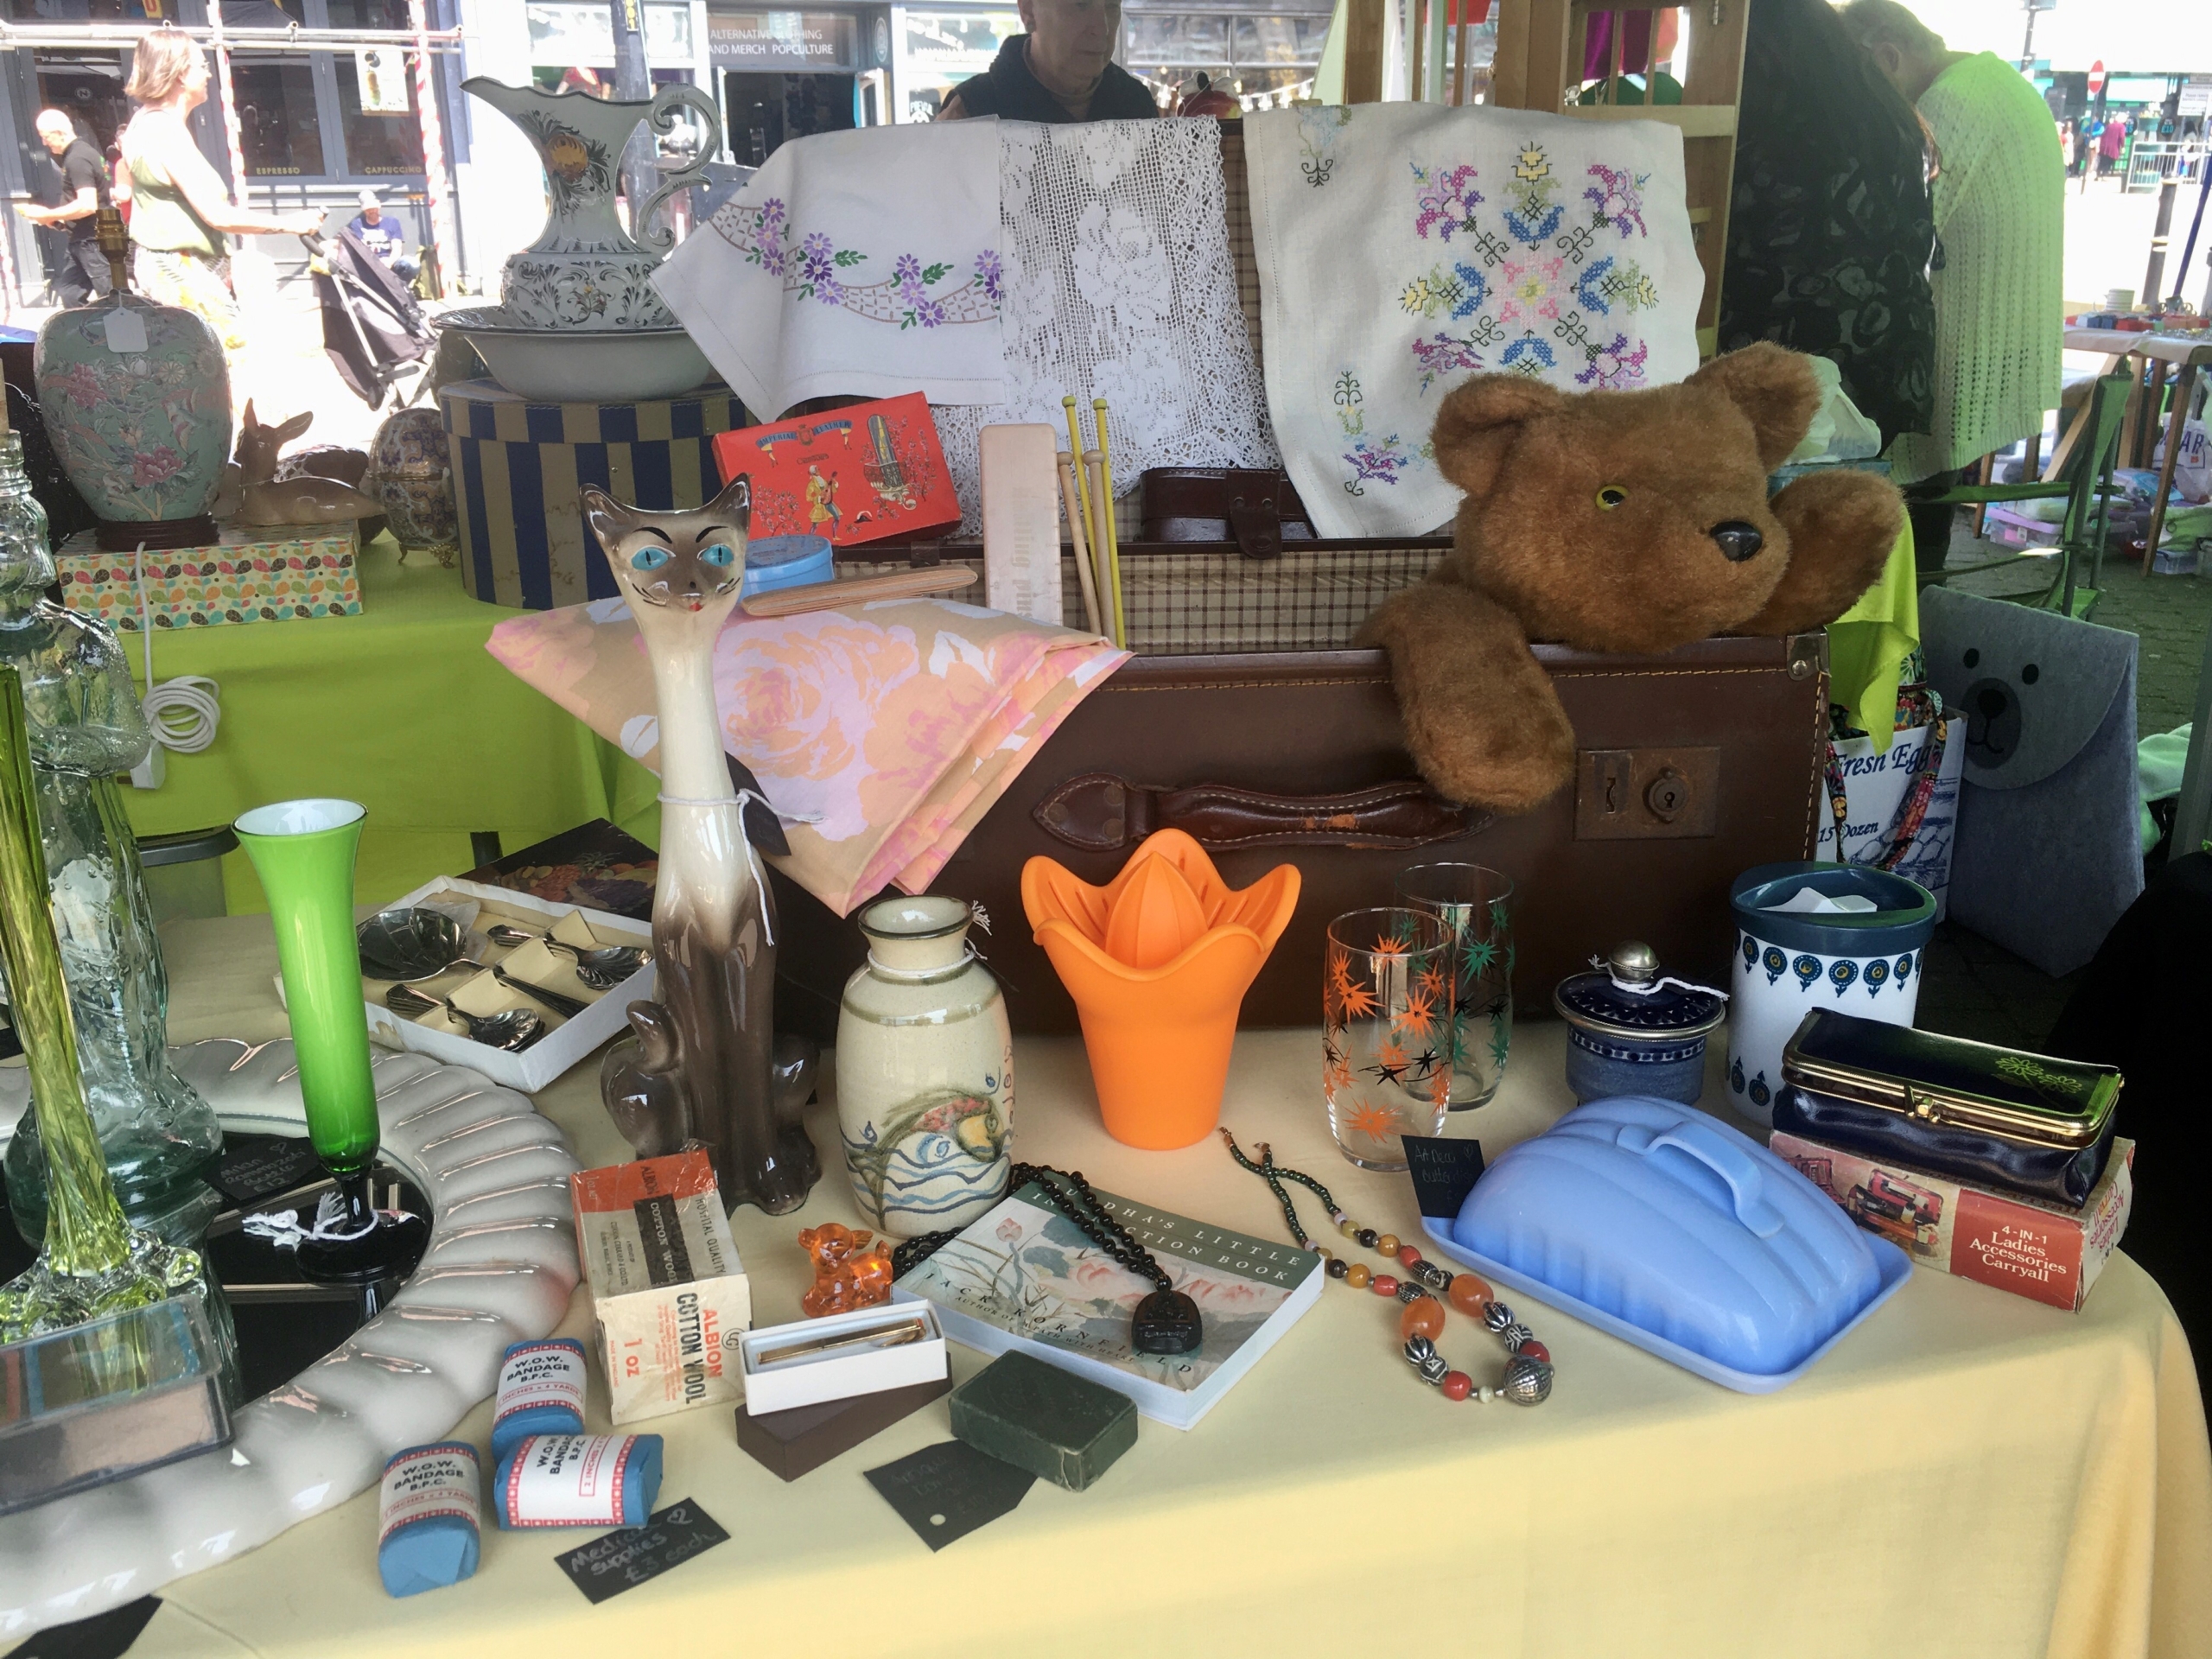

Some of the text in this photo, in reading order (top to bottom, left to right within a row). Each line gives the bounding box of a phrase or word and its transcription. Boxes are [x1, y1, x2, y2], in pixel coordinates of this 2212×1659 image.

[710, 29, 772, 40] ALTERNATIVE
[709, 44, 834, 54] AND MERCH POPCULTURE
[365, 166, 423, 175] CAPPUCCINO
[760, 420, 852, 447] IMPERIAL LEATHER
[1818, 827, 1834, 843] 15
[640, 1166, 660, 1194] ALBION
[650, 1202, 669, 1246] COTTON
[695, 1198, 728, 1274] HOSPITAL QUALITY
[1194, 1230, 1300, 1266] LITTLE
[1969, 1238, 2067, 1274] Accessories
[1991, 1231, 2046, 1257] Ladies
[1217, 1255, 1289, 1281] BOOK
[1981, 1253, 2050, 1283] Carryall
[677, 1293, 702, 1356] COTTON
[925, 1272, 1192, 1373] JACK KORNFIELD
[955, 1296, 998, 1317] AUTHOR
[1001, 1313, 1016, 1322] OF
[1030, 1325, 1062, 1340] PATH
[1065, 1338, 1095, 1351] WITH
[1096, 1348, 1136, 1363] HEART
[624, 1338, 643, 1348] 1
[702, 1308, 723, 1379] ALBION
[507, 1363, 570, 1382] BANDAGE
[515, 1356, 563, 1369] W.O.W.
[520, 1372, 554, 1383] B.P.C.
[683, 1358, 706, 1405] WOOL
[394, 1469, 465, 1491] BANDAGE
[403, 1460, 456, 1477] W.O.W.
[410, 1478, 447, 1491] B.P.C.
[665, 1532, 718, 1562] each
